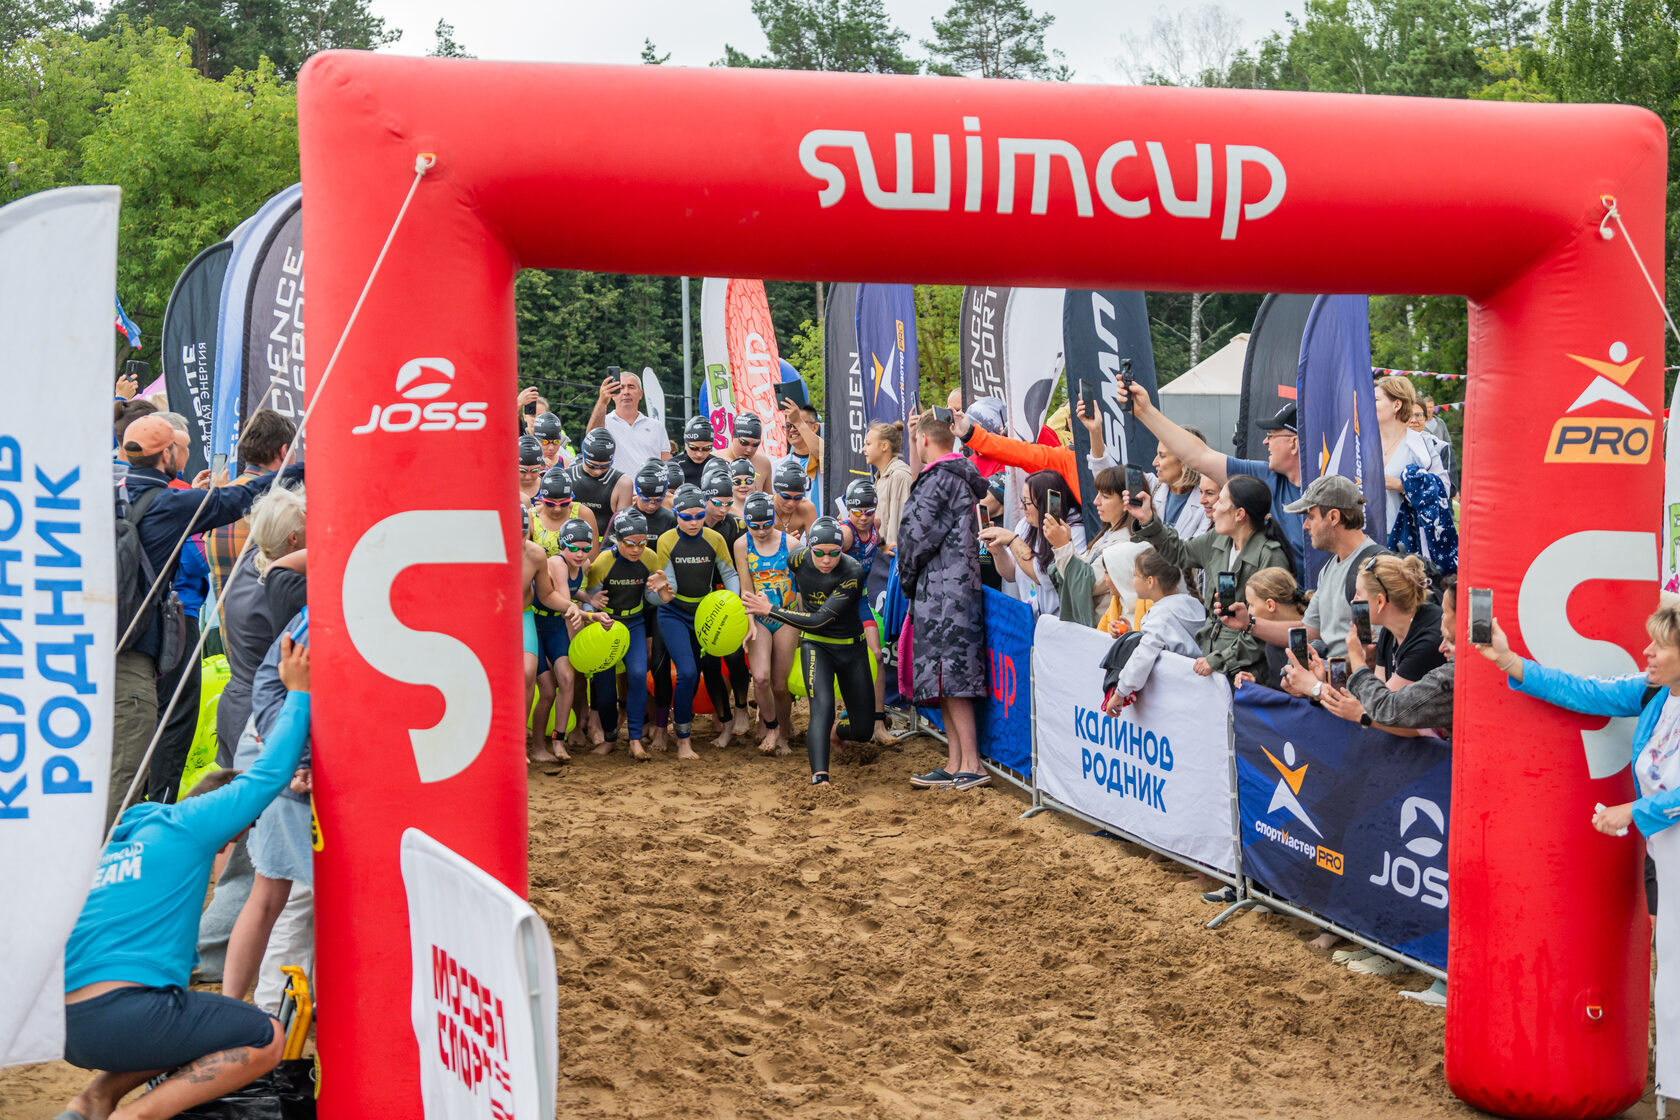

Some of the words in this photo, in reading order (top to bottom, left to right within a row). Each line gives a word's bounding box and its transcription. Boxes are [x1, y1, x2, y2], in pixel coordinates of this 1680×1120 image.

[798, 116, 1287, 240] swimcup
[267, 246, 304, 417] CIENCE
[971, 290, 985, 400] IENCE
[198, 342, 210, 399] ЭНЕРГИЯ
[352, 402, 488, 435] JOSS
[849, 352, 863, 454] SCIEN
[1554, 426, 1649, 456] PRO
[34, 465, 97, 795] РОДНИК
[701, 600, 726, 636] FitSmile
[1082, 747, 1167, 813] РОДНИК
[91, 856, 142, 889] EAM
[1318, 849, 1342, 870] PRO
[1370, 851, 1449, 909] JOS
